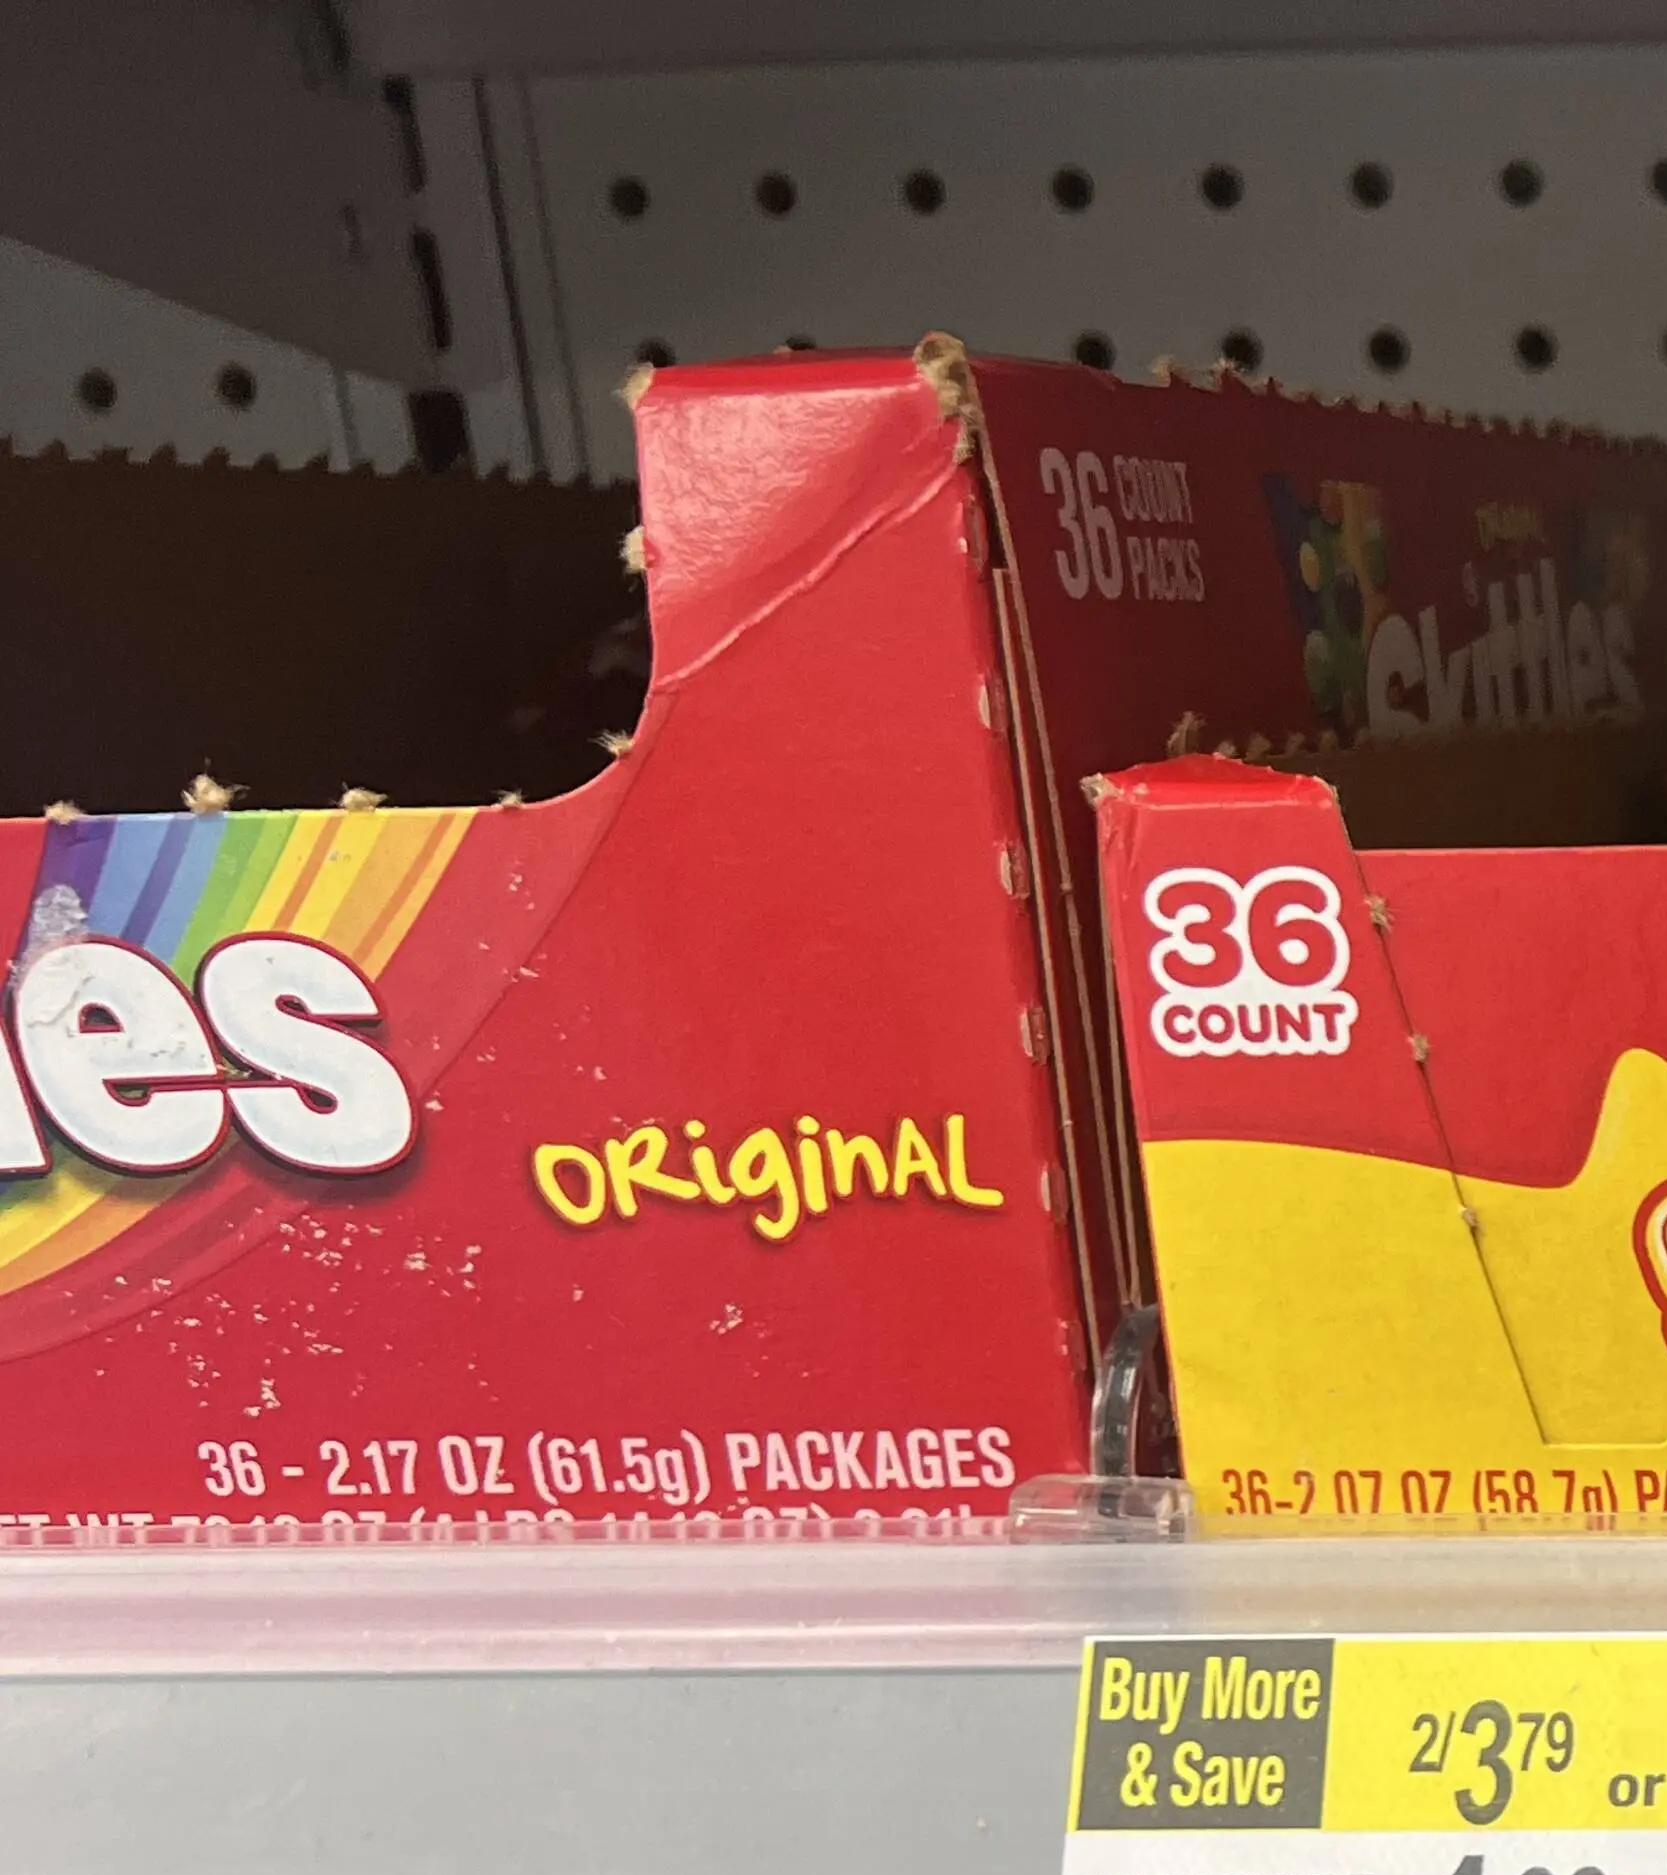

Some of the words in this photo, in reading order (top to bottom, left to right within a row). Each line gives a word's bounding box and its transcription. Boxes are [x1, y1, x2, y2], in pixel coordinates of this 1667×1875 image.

[1039, 447, 1125, 601] 36
[1113, 453, 1193, 524] COUNT
[1125, 534, 1205, 603] PACKS
[1150, 872, 1345, 988] 36
[1160, 999, 1346, 1047] COUNT
[198, 1439, 266, 1498] 36
[319, 1436, 418, 1498] 2.17
[439, 1435, 514, 1496] OZ
[528, 1429, 711, 1507] (61.5g)
[729, 1427, 1016, 1493] PACKAGES
[1098, 1656, 1189, 1735] Buy
[1199, 1655, 1322, 1721] More
[1119, 1742, 1158, 1808] &
[1170, 1741, 1286, 1808] Save
[1607, 1772, 1667, 1809] or
